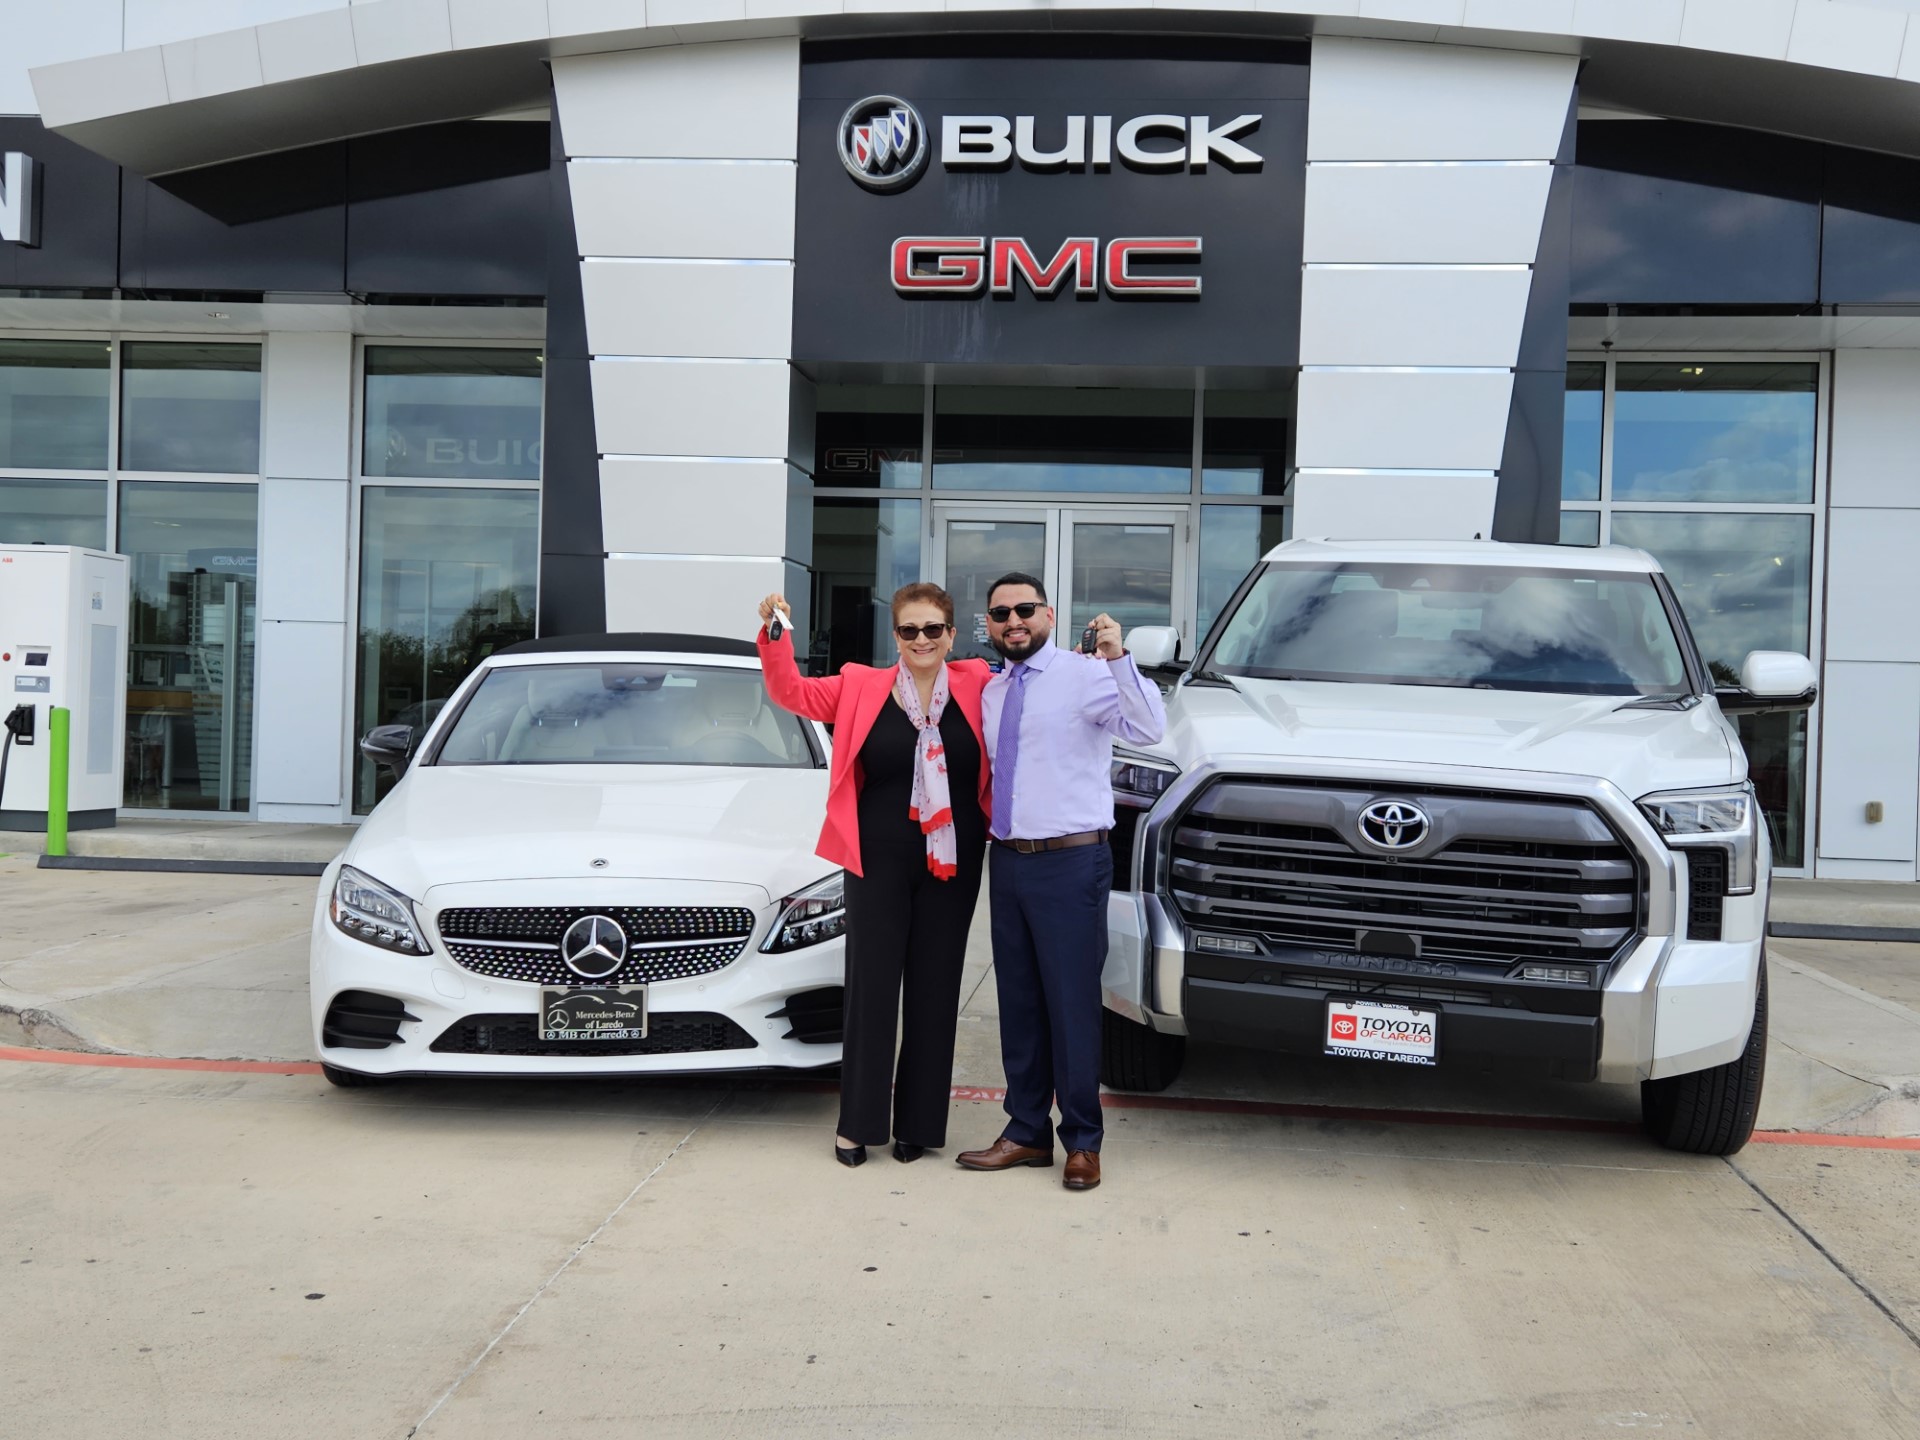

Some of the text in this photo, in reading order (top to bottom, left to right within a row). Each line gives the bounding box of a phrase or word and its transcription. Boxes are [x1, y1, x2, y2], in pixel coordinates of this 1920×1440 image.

[941, 114, 1264, 165] BUICK
[891, 236, 1202, 295] GMC
[1313, 951, 1456, 976] TUNDRA
[575, 1011, 636, 1019] Mercedes-Benz
[585, 1021, 624, 1029] of Laredo
[1361, 1017, 1432, 1036] TOYOTA
[559, 1030, 628, 1039] MB of Laredo
[1360, 1029, 1378, 1038] OF
[1381, 1031, 1432, 1044] LAREDO
[1332, 1047, 1371, 1059] TOYOTA
[1372, 1051, 1386, 1060] OF
[1387, 1053, 1428, 1065] LAREDO
